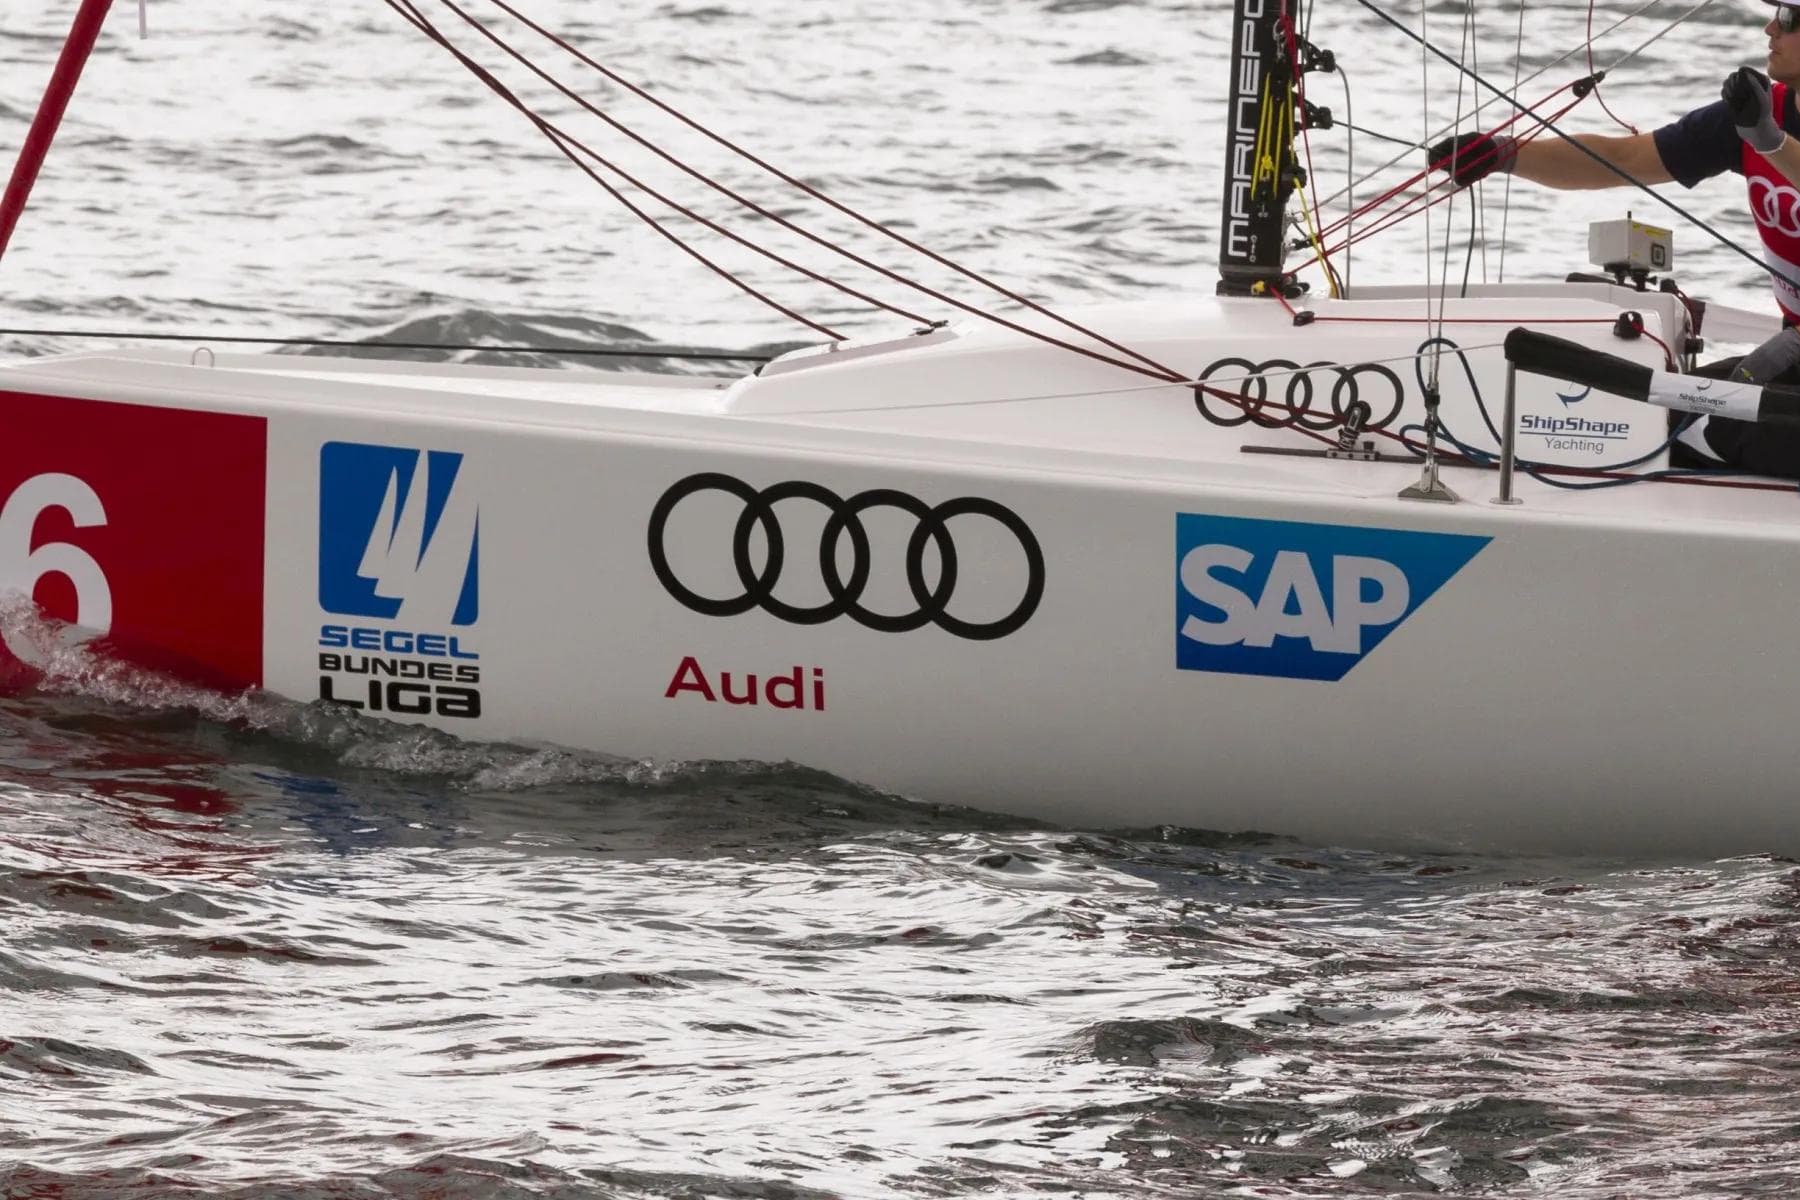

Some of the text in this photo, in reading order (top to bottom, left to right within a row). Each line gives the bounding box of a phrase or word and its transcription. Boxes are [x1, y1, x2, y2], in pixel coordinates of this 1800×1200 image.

[1520, 414, 1630, 435] ShipShape
[1544, 436, 1604, 455] Yachting
[1180, 543, 1410, 655] SAP
[318, 624, 479, 660] SEGEL
[318, 652, 480, 684] BUNDES
[664, 655, 825, 712] Audi
